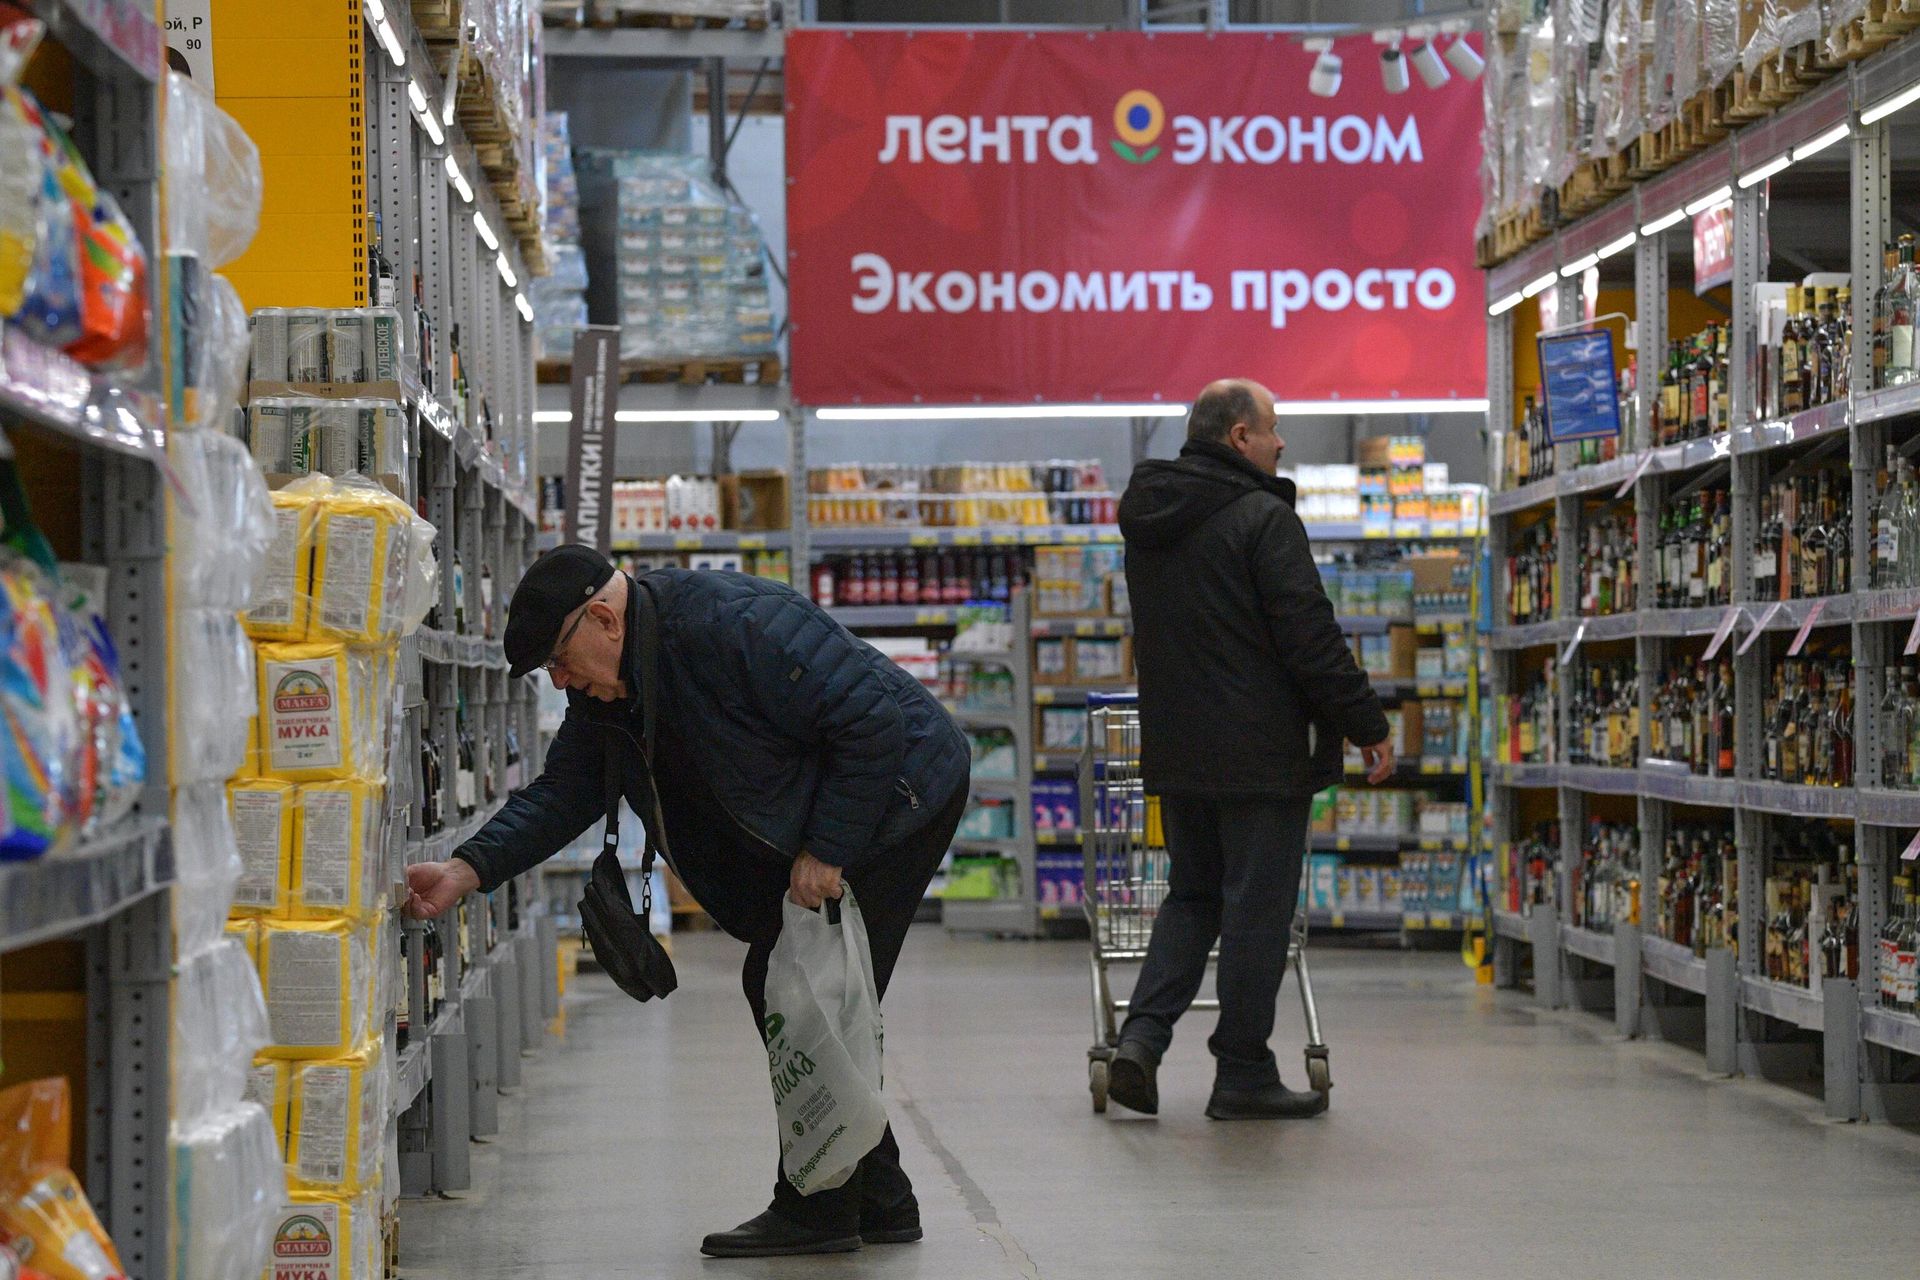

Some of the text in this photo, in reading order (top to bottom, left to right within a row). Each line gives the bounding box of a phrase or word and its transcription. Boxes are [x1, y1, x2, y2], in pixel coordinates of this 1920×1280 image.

[186, 39, 202, 50] 90
[878, 114, 1423, 165] лента эконом
[851, 253, 1456, 328] Экономить просто
[278, 725, 329, 739] МУКА
[280, 1243, 325, 1253] MAKFA
[276, 1270, 329, 1280] МУКА
